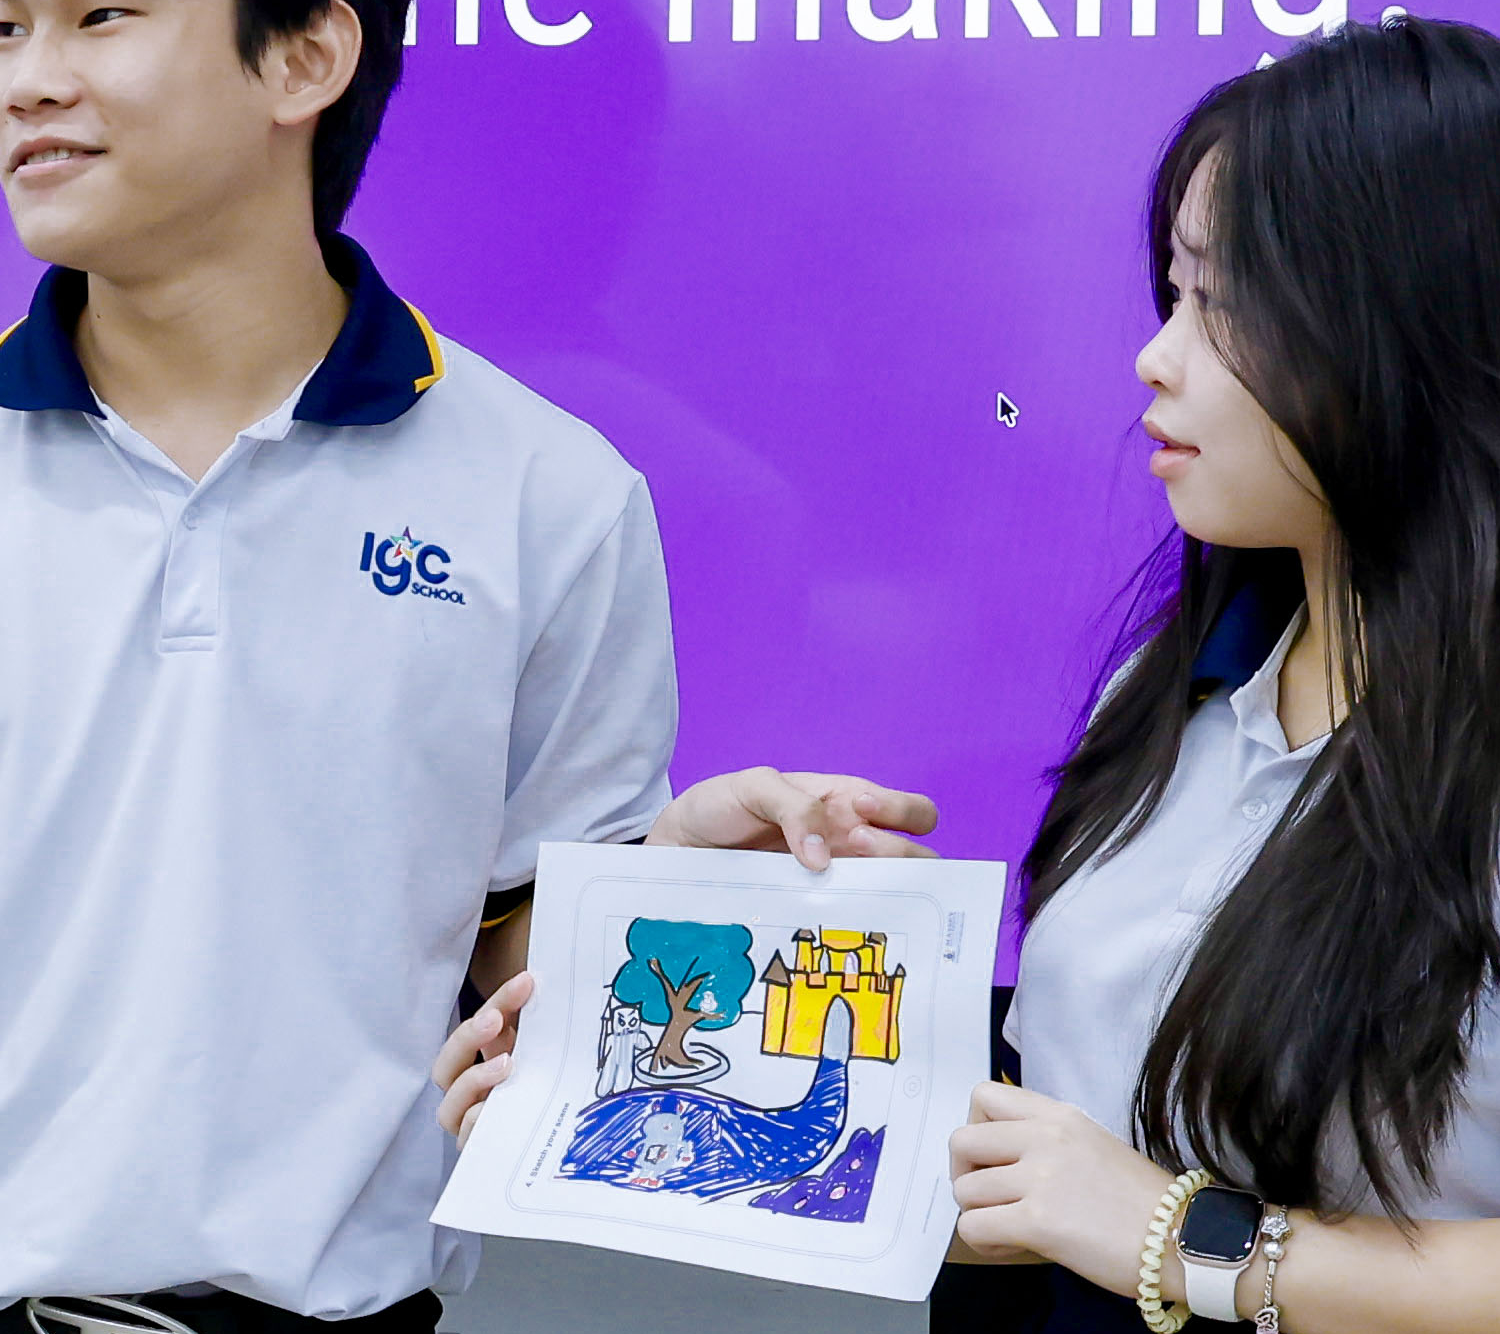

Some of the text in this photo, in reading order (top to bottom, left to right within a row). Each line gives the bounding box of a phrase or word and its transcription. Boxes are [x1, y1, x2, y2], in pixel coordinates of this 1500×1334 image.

[411, 582, 467, 605] SCHOOL
[530, 1149, 548, 1177] Sketch
[545, 1129, 557, 1148] your
[555, 1102, 570, 1127] scene
